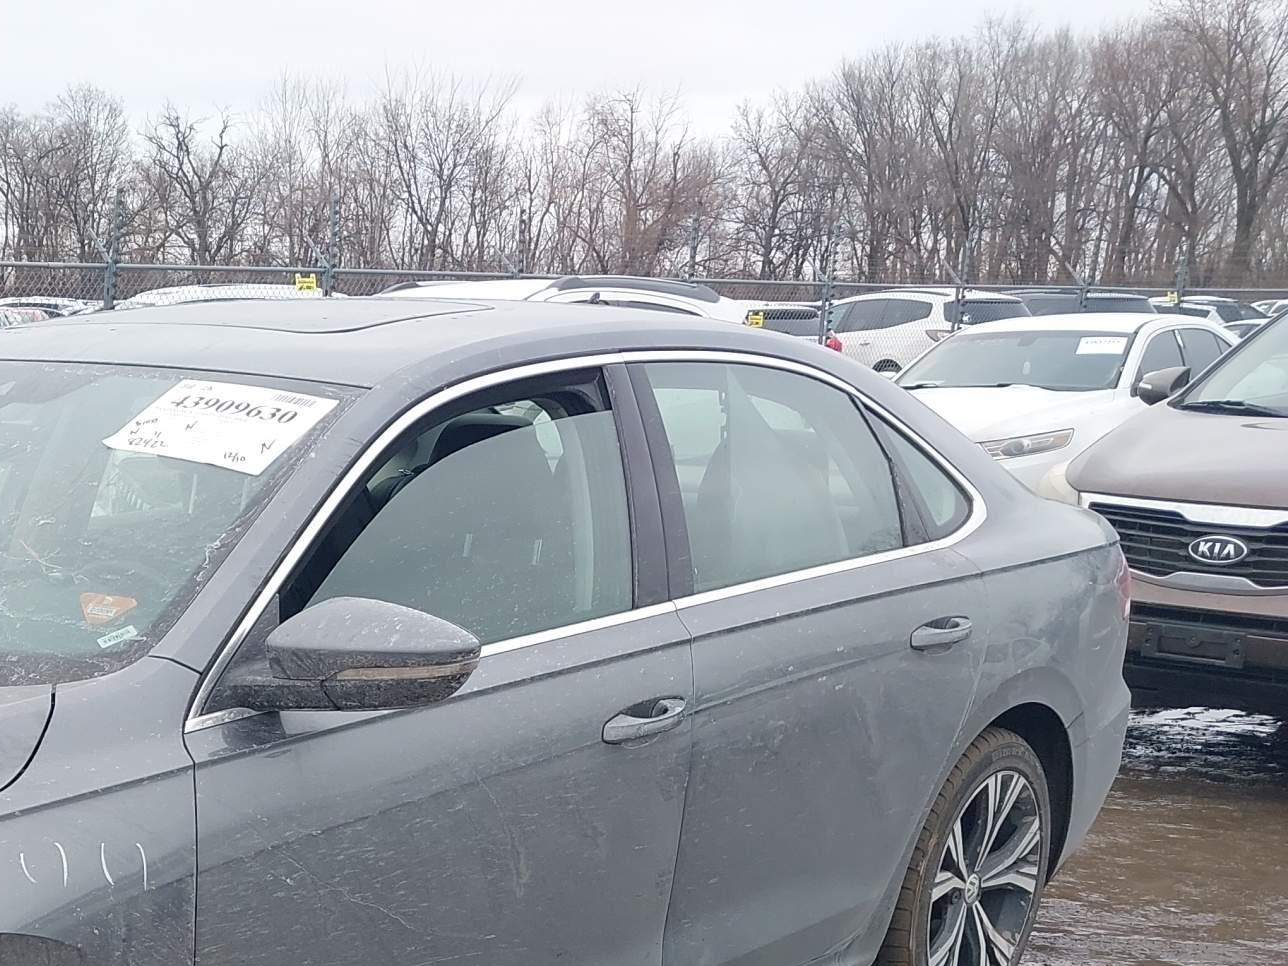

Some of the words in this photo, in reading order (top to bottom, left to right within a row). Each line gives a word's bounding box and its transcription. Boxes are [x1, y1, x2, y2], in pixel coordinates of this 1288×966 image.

[171, 395, 298, 424] 43909630
[223, 451, 247, 463] 12/10
[1197, 541, 1236, 561] KIA
